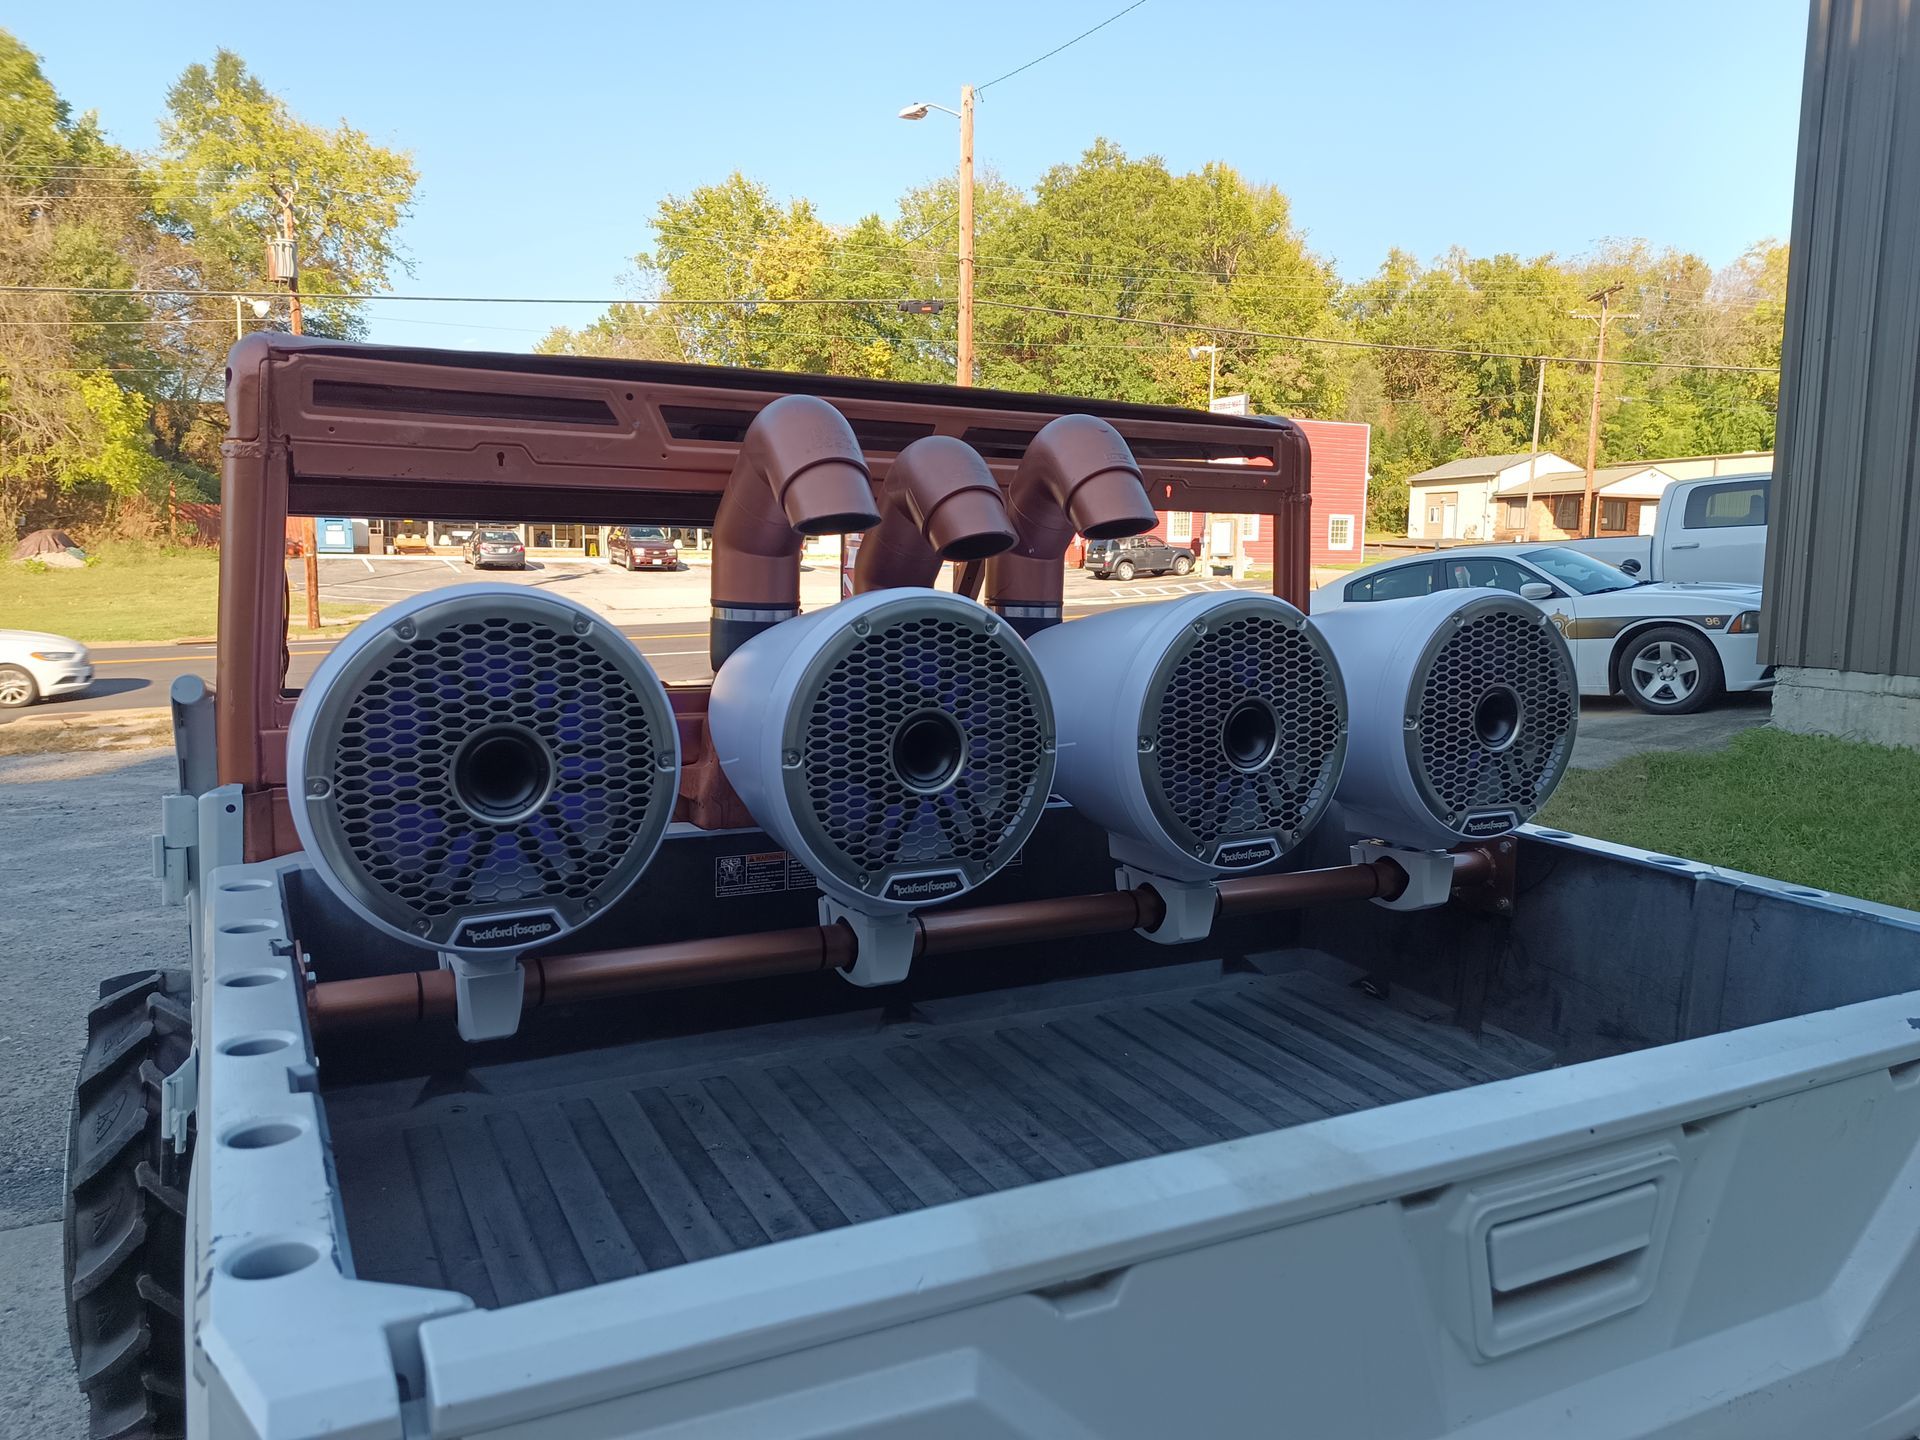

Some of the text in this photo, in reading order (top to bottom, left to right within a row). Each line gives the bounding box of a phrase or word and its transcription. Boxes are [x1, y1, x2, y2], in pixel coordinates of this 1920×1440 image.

[1705, 617, 1720, 626] 96
[1221, 851, 1248, 863] Rockford
[893, 882, 928, 897] Rockford
[466, 926, 513, 944] Rockford
